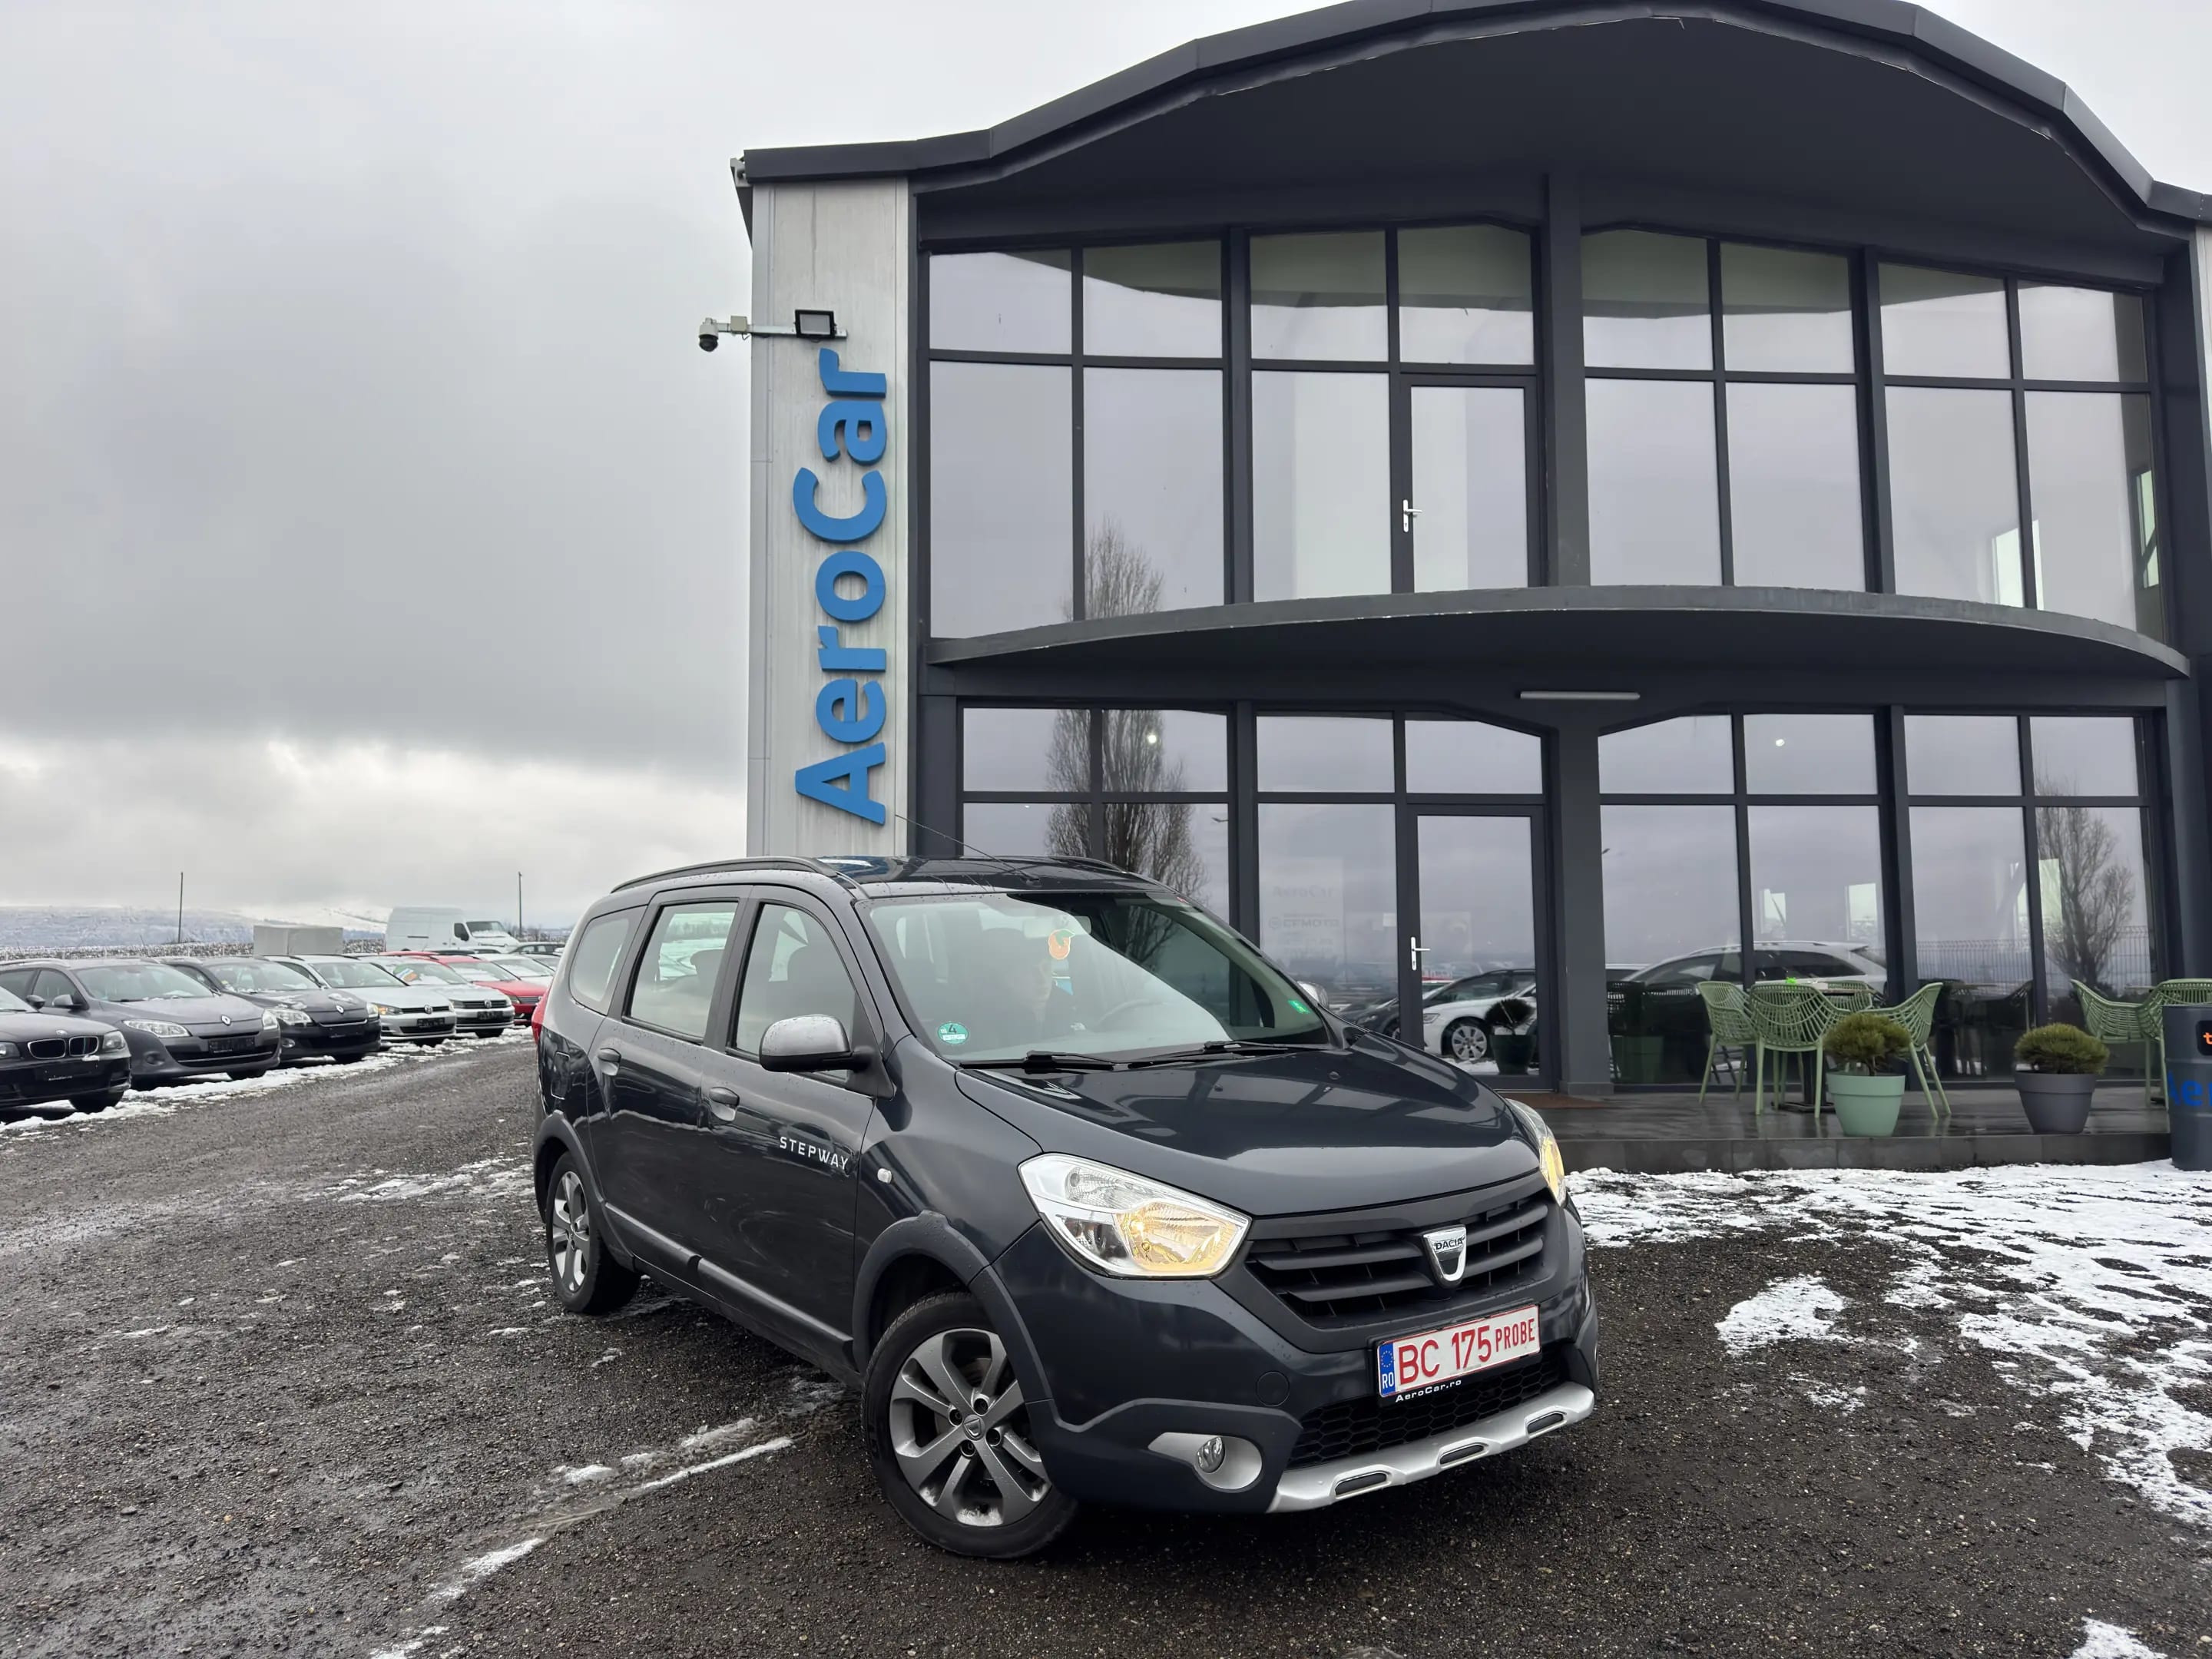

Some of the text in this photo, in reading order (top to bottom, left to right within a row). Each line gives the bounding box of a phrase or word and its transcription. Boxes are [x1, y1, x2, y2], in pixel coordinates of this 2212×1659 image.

[793, 348, 887, 826] AeroCar
[780, 1136, 849, 1170] STEPWAY
[1435, 1238, 1463, 1250] DACIA
[1398, 1318, 1535, 1386] BC 175 PROBE
[1382, 1372, 1395, 1389] RO
[1395, 1379, 1462, 1403] AeroCar.ro
